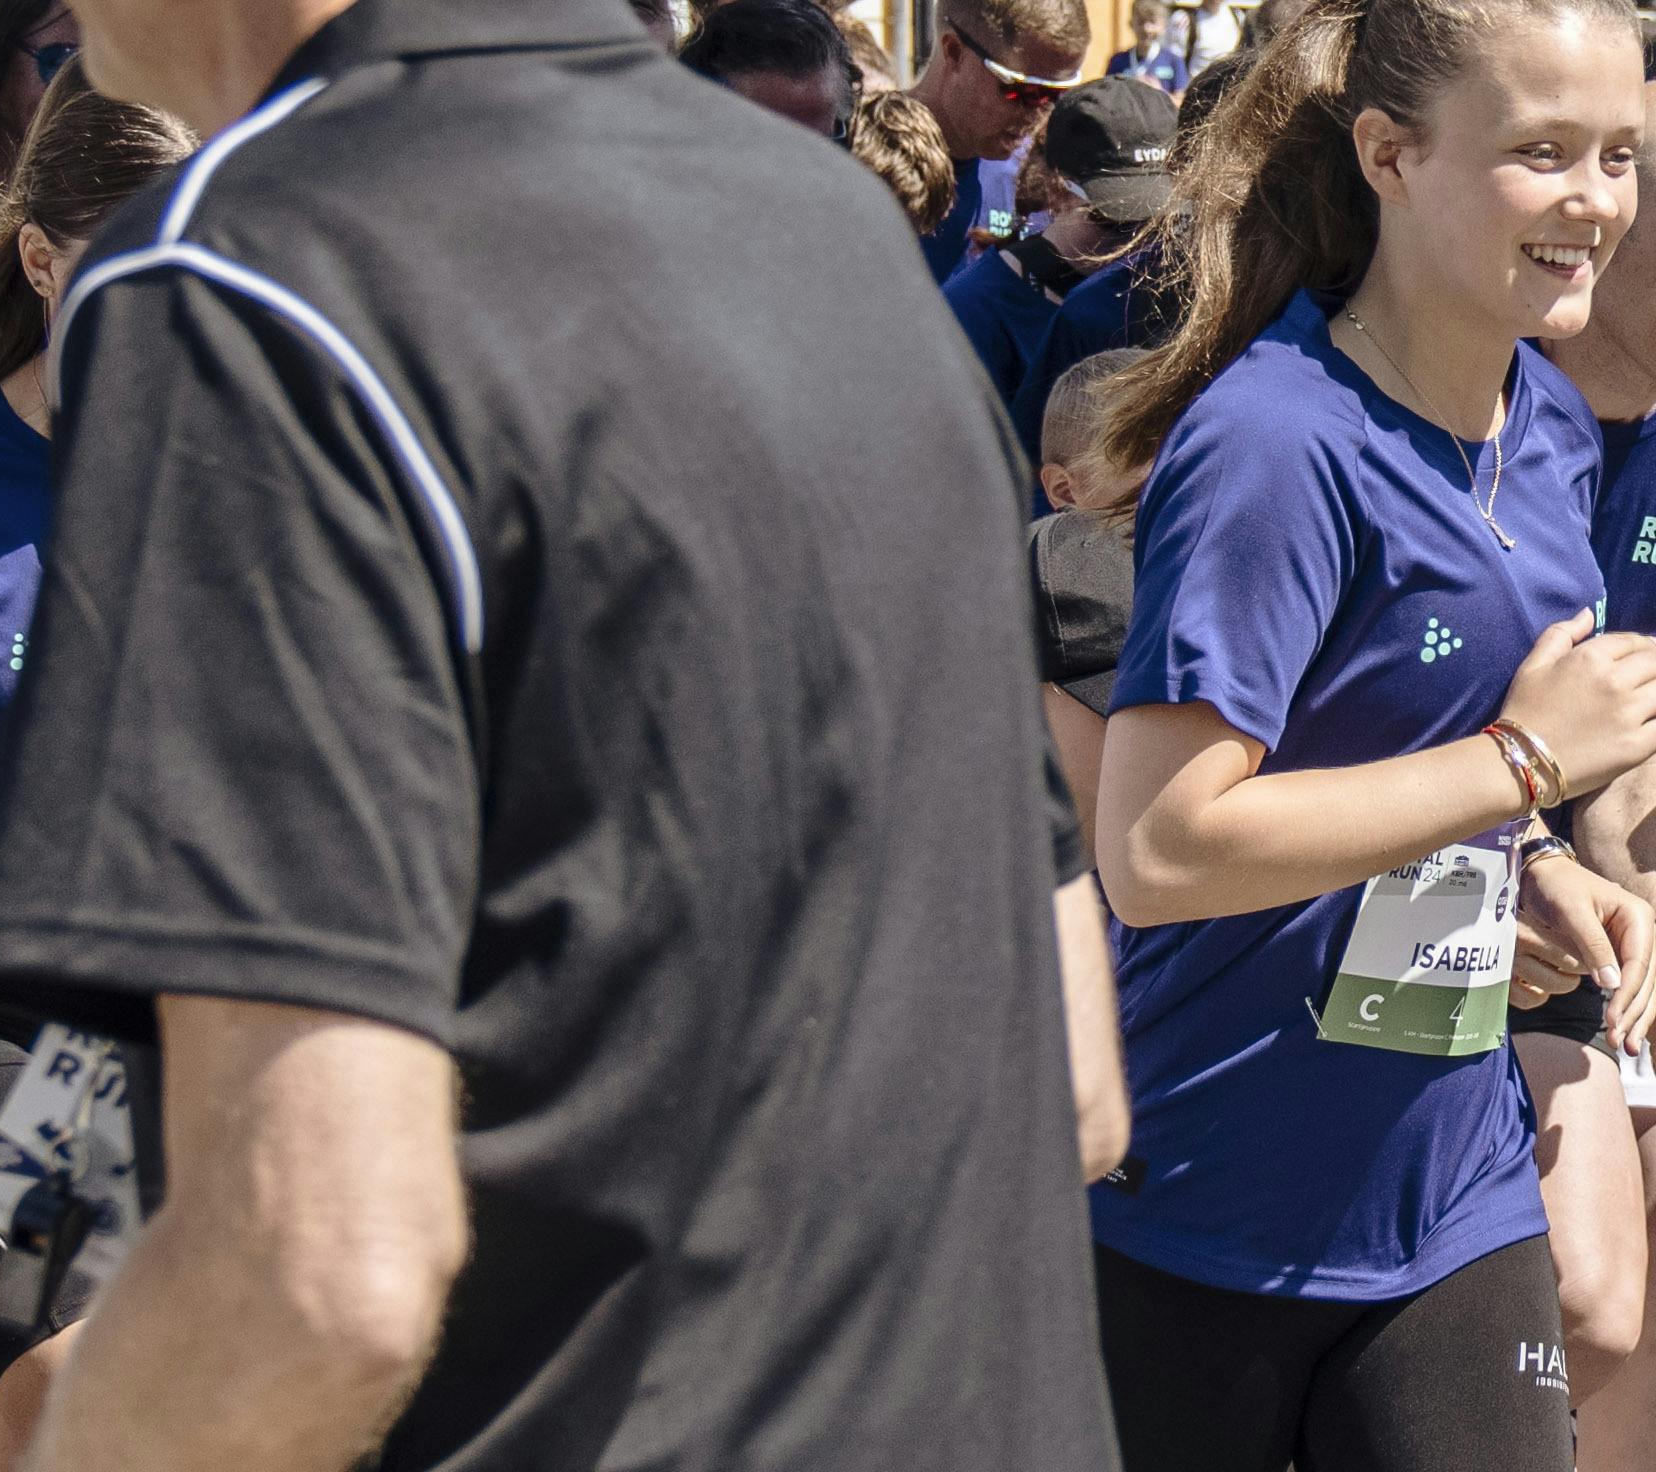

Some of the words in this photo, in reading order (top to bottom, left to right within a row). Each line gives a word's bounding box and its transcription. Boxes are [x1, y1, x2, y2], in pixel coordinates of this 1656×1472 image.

[1411, 942, 1500, 971] ISABELLA
[1359, 993, 1385, 1022] C
[1449, 995, 1465, 1027] 4
